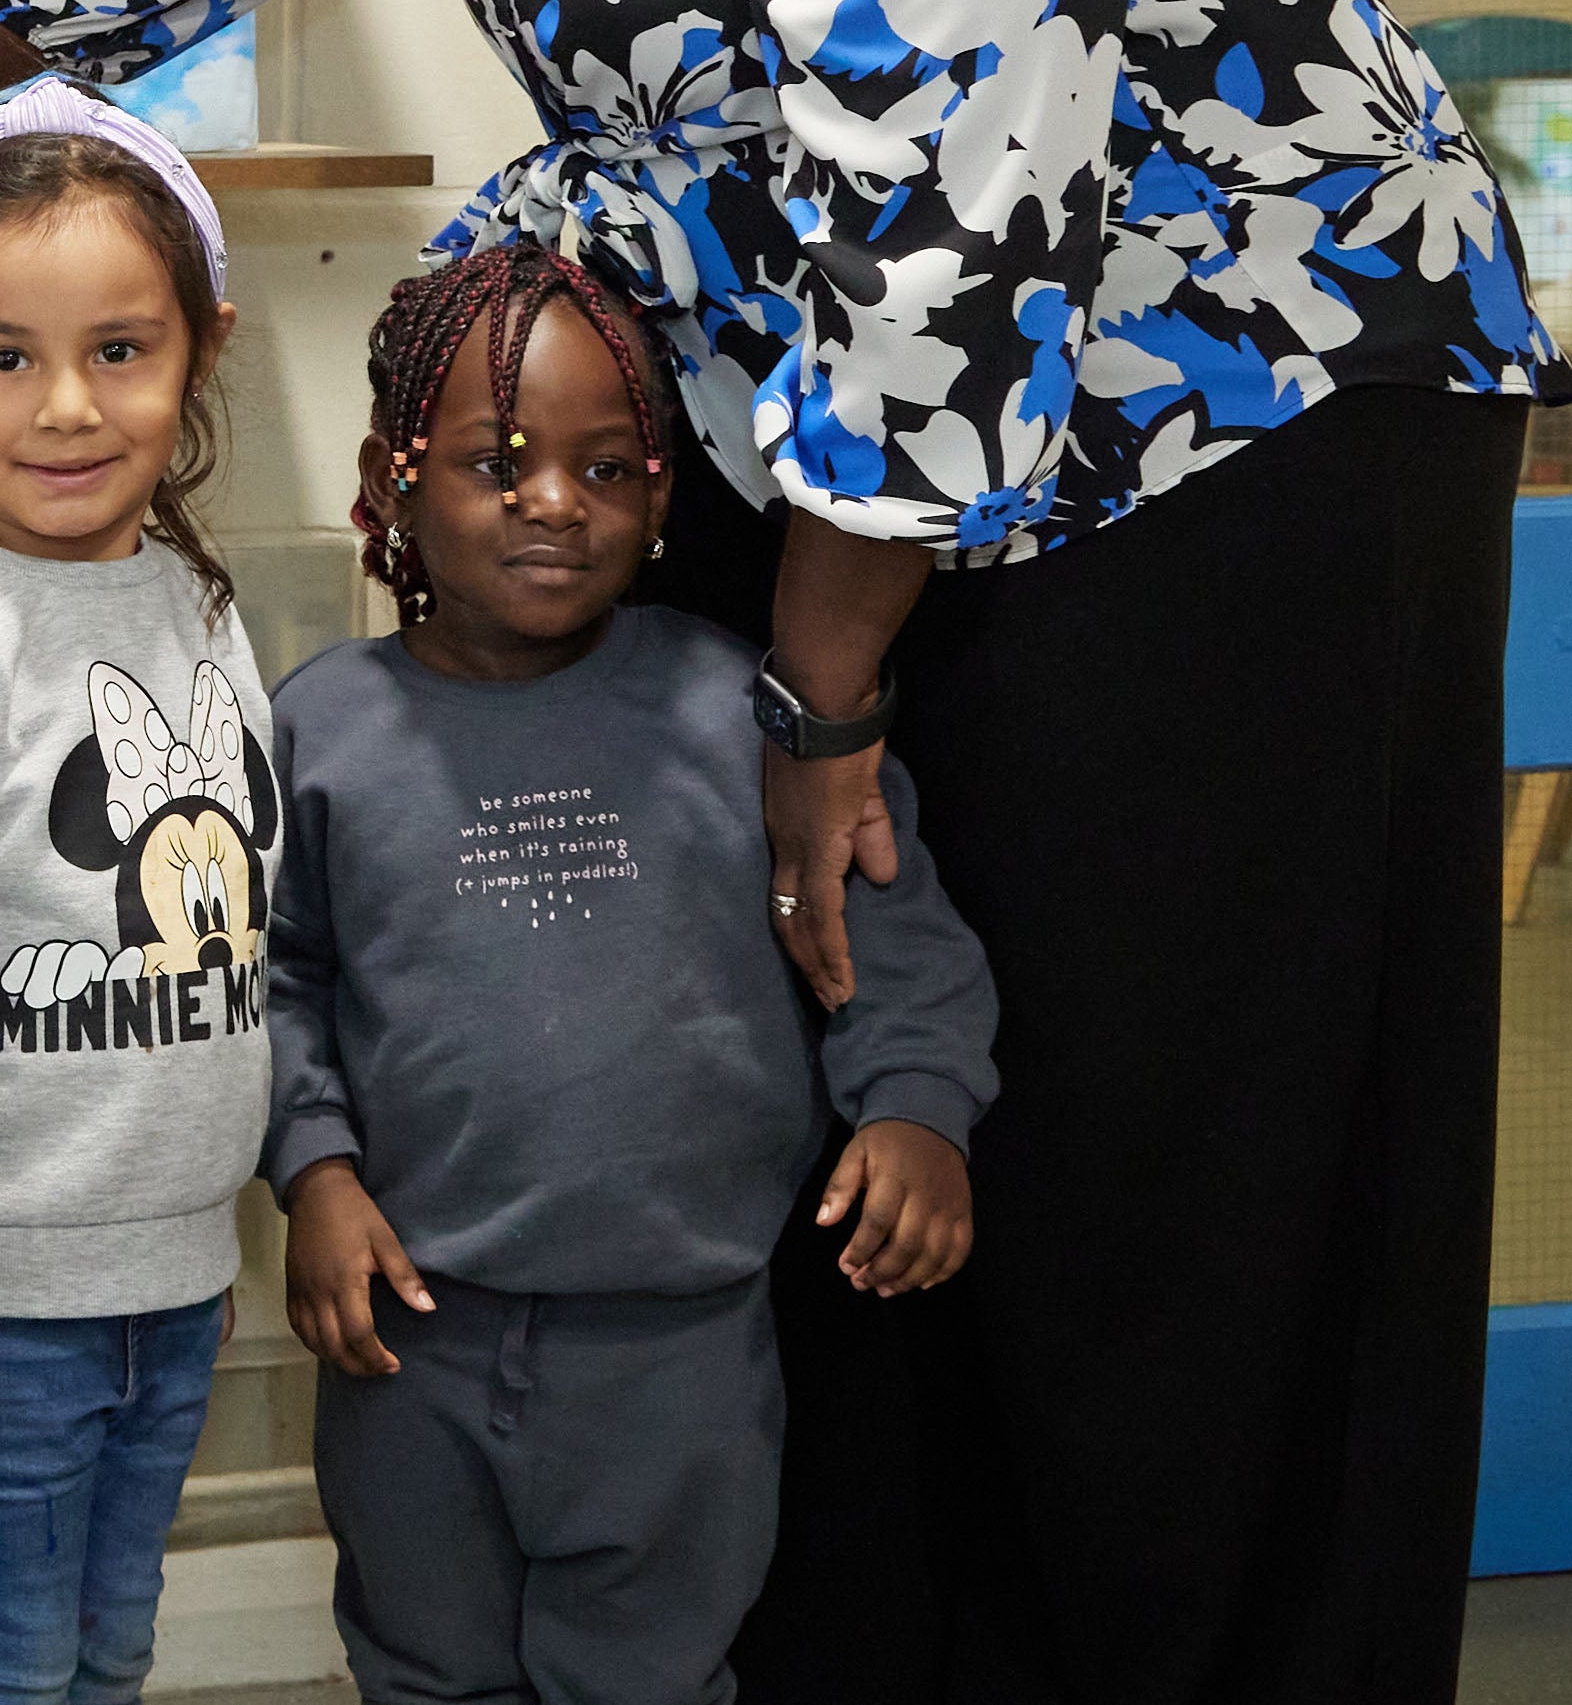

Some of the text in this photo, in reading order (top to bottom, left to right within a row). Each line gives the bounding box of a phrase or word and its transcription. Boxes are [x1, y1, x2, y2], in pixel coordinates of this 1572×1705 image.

[479, 787, 592, 812] be someone
[460, 812, 620, 838] who smiles even
[460, 835, 628, 865] when it's raining
[481, 873, 530, 895] jumps
[537, 869, 553, 883] in
[562, 862, 639, 886] puddles!)
